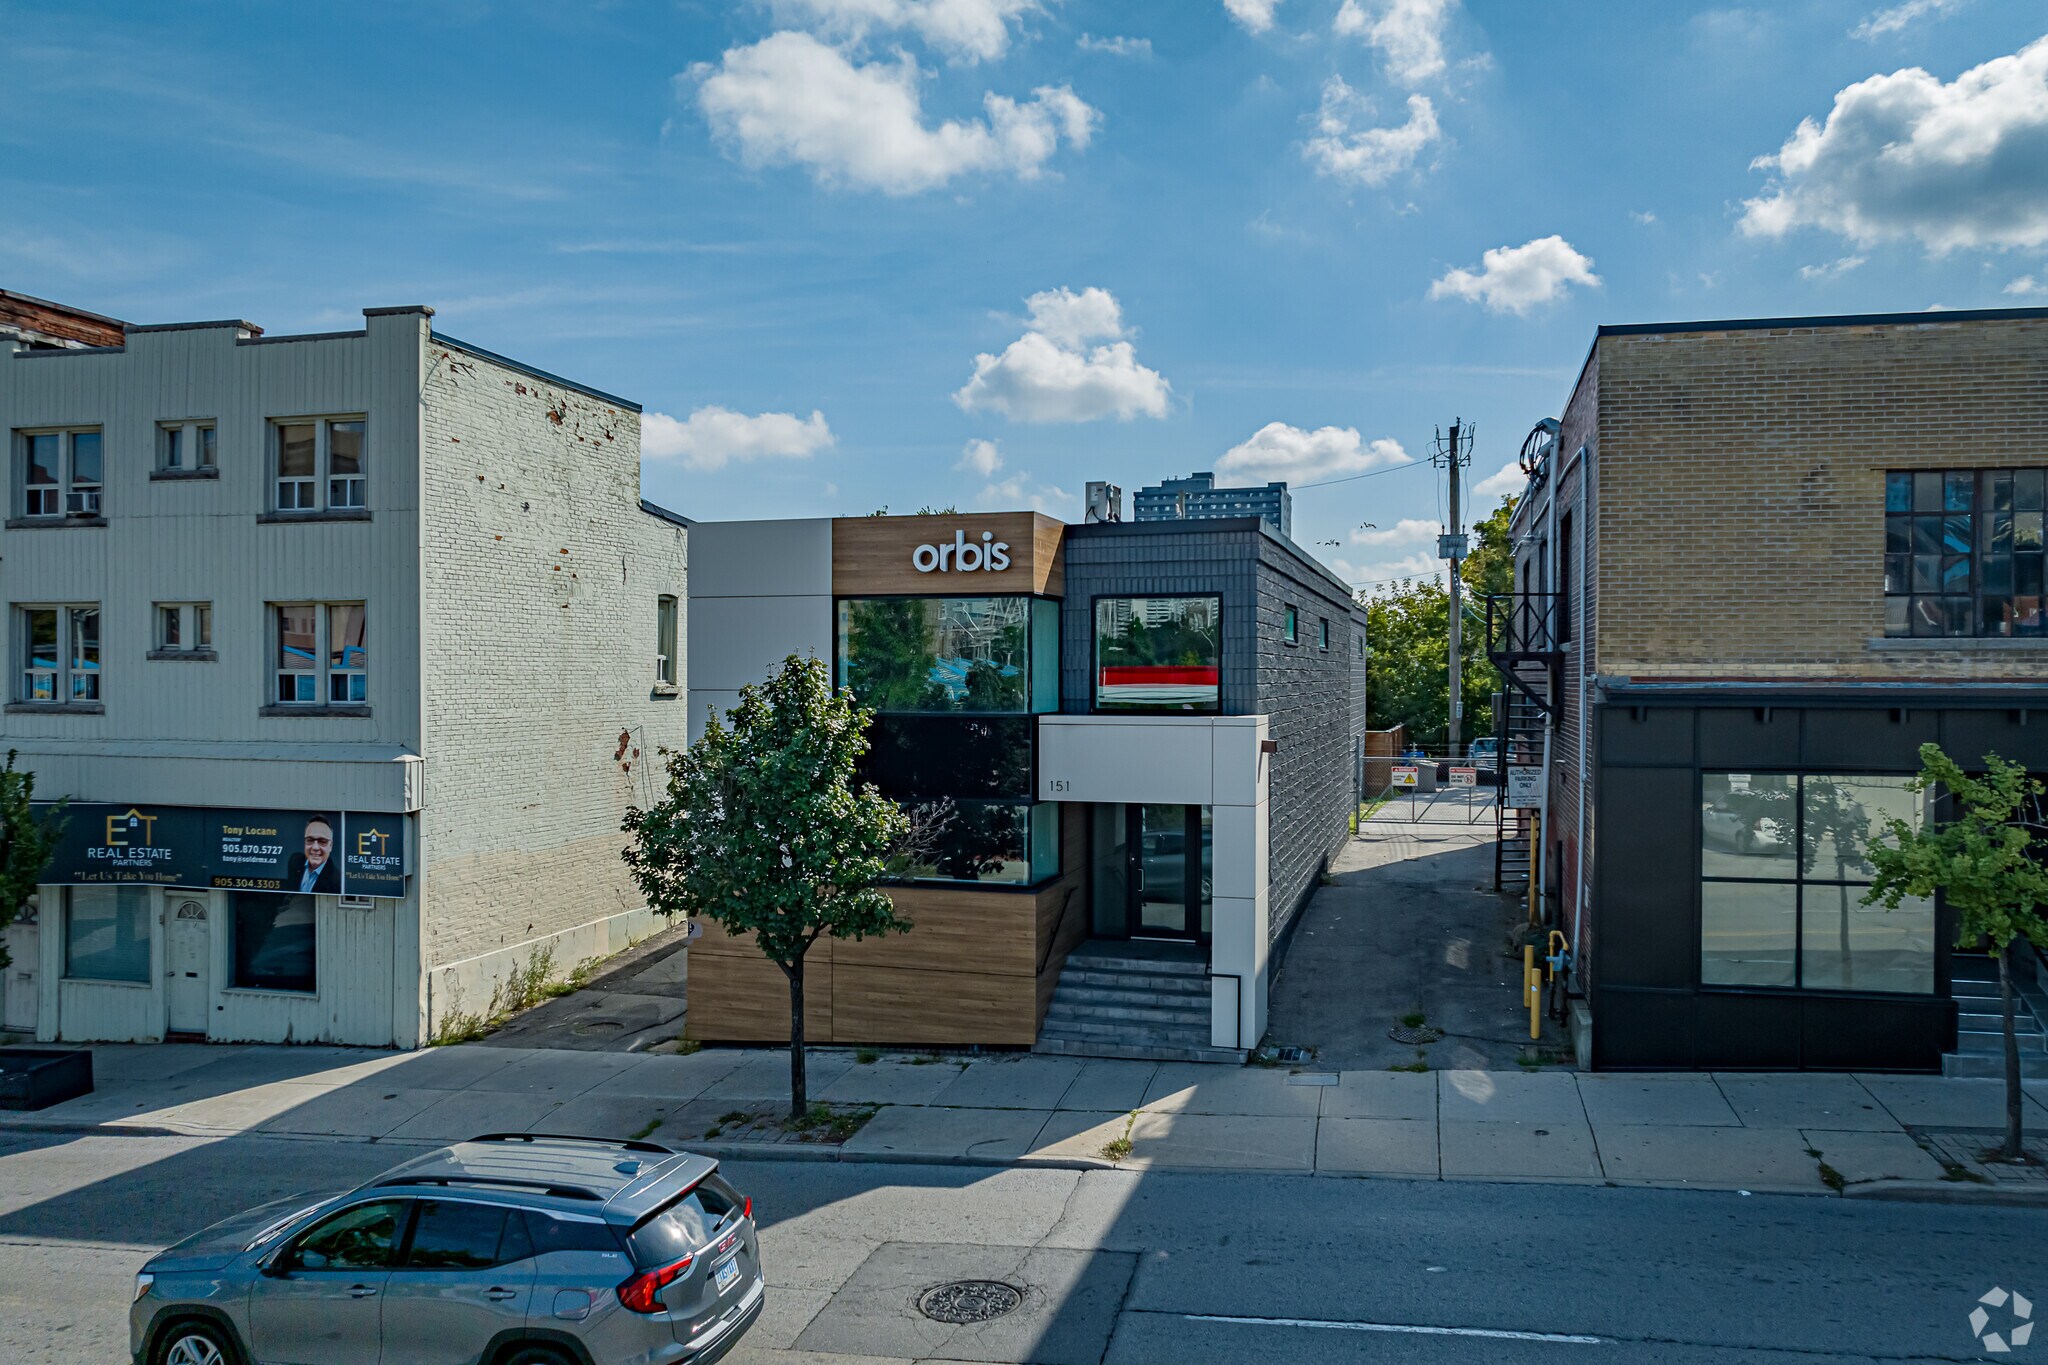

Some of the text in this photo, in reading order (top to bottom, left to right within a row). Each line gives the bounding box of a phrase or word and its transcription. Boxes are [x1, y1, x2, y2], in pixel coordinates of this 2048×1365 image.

[912, 529, 1011, 573] orbis
[1050, 780, 1070, 792] 151
[222, 825, 278, 836] Tony Locane
[87, 847, 172, 860] REAL ESTATE
[222, 844, 283, 855] 905.870.5727
[112, 859, 153, 867] PARTNERS
[347, 855, 400, 865] REAL ESTATE
[214, 877, 281, 889] 905.304.3303
